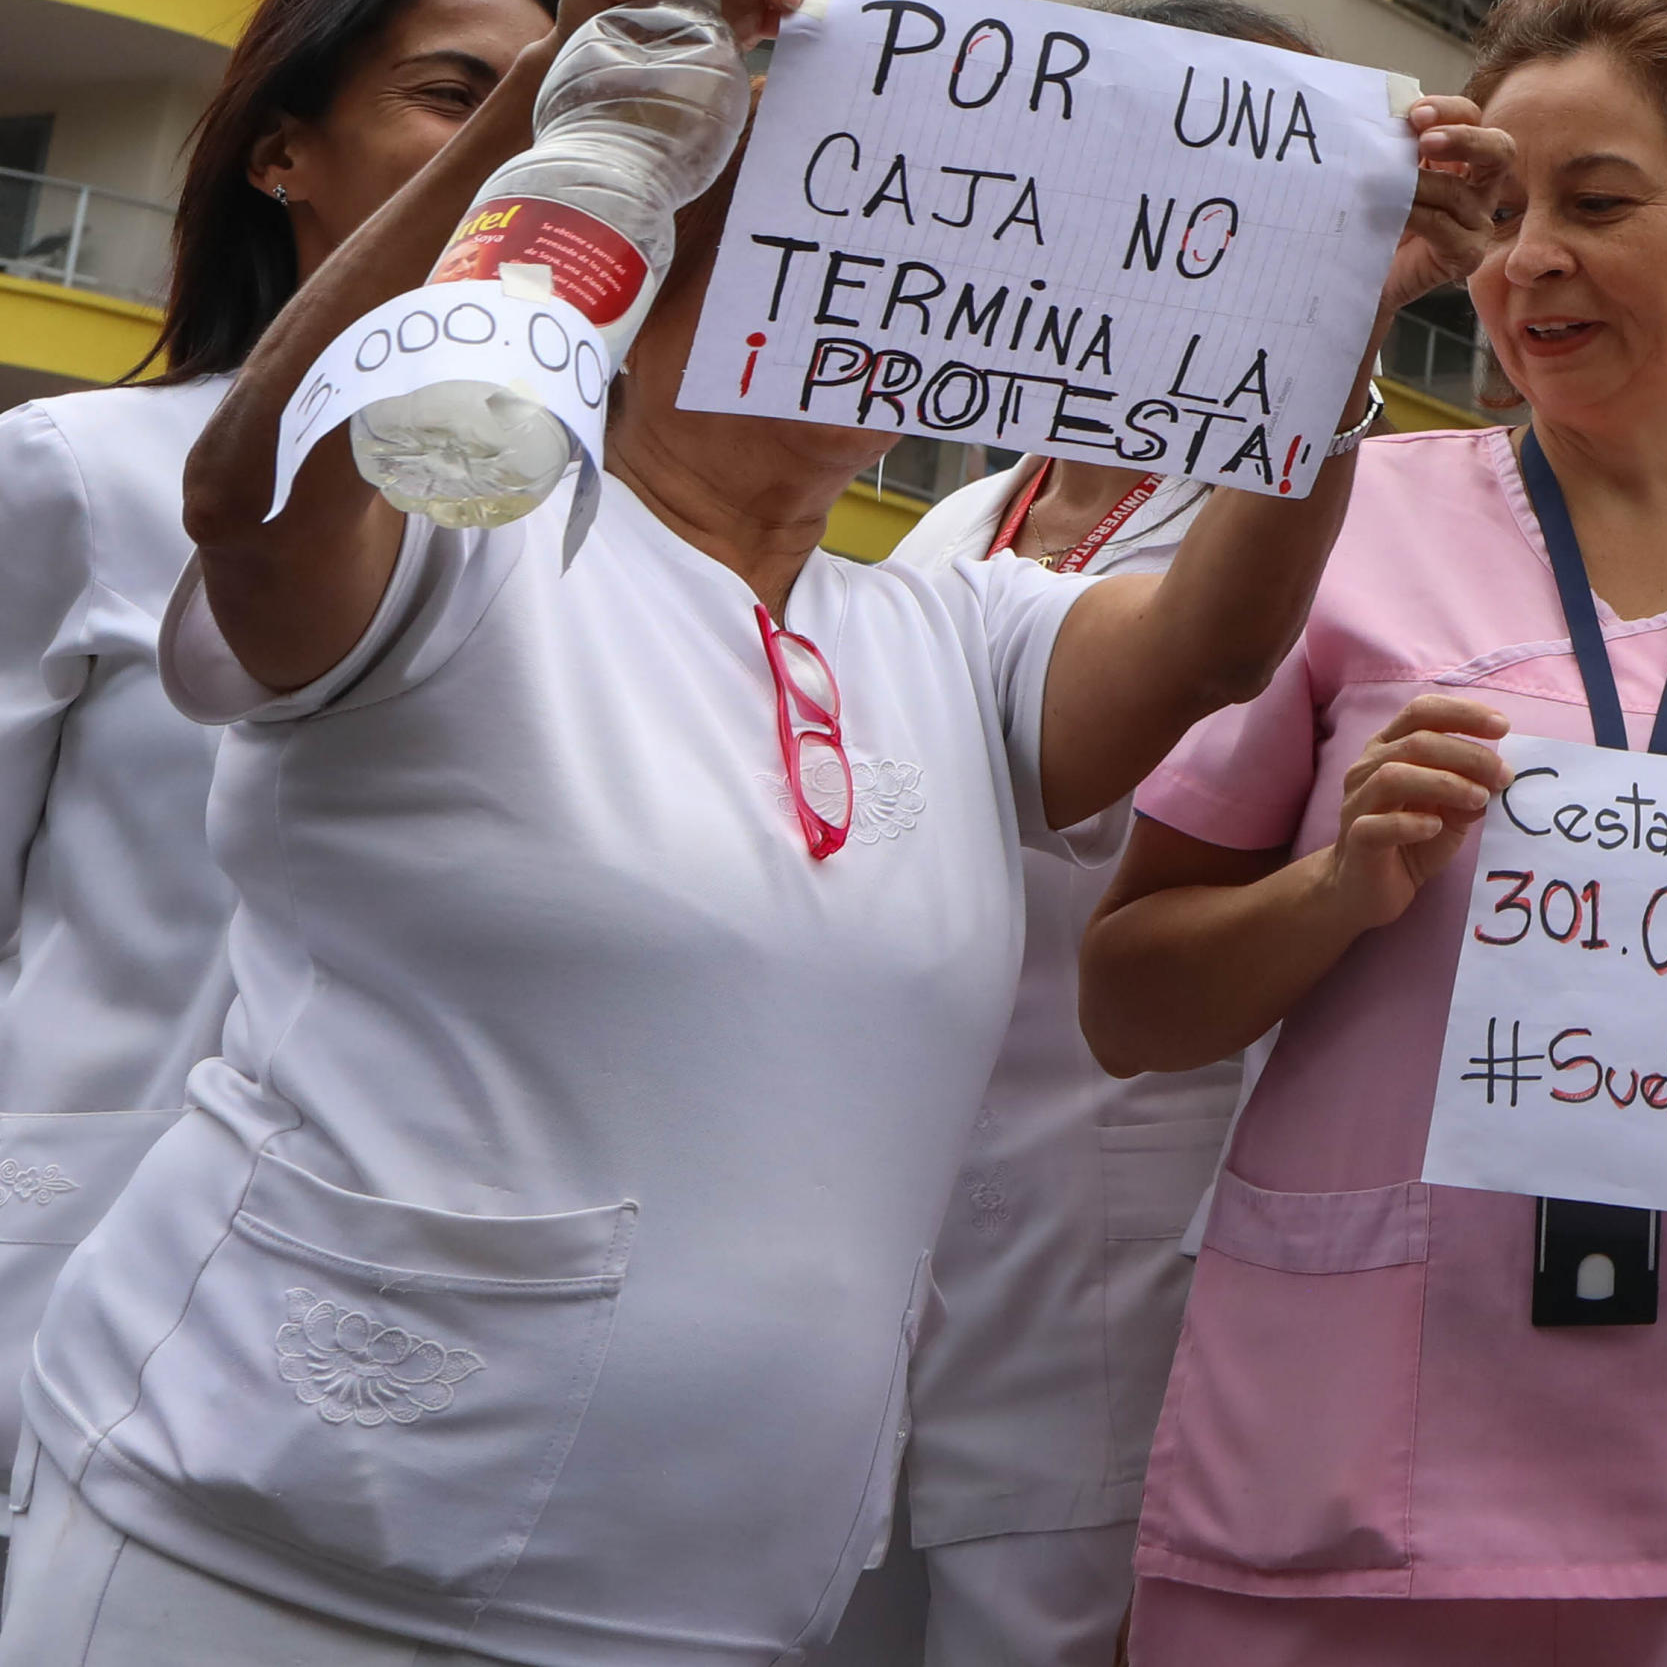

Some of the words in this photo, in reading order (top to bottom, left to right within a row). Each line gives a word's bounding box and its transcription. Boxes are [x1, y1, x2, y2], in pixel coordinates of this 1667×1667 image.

[862, 0, 1091, 119] POR
[1175, 65, 1322, 164] UNA
[804, 132, 1044, 245] CAJA
[1124, 193, 1239, 279] NO
[752, 234, 1113, 375] TERMINA
[1167, 334, 1272, 415] LA
